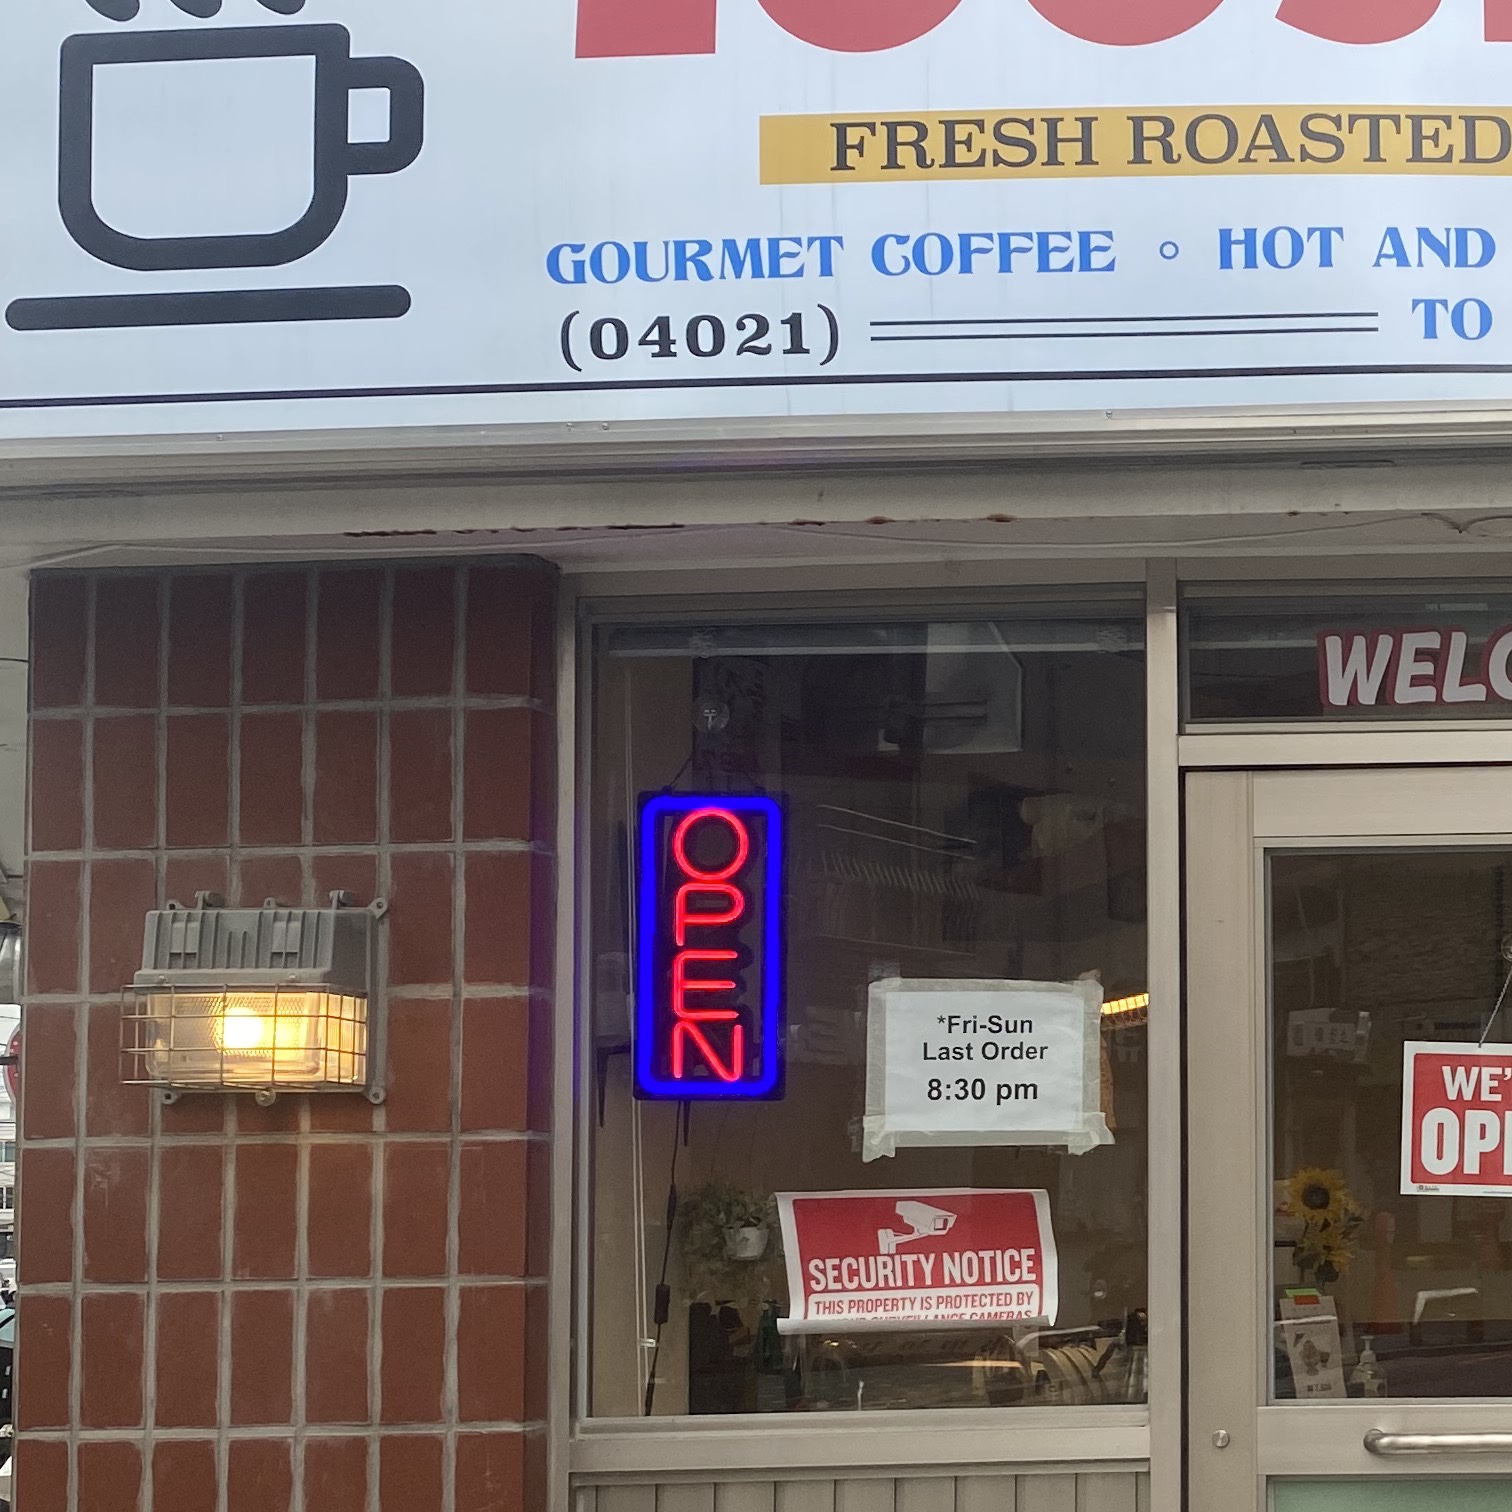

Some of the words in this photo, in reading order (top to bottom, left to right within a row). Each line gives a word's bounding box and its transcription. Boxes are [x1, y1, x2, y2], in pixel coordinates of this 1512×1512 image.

[830, 115, 1099, 171] FRESH
[1127, 113, 1512, 165] ROASTED
[545, 234, 845, 285] GOURMET
[870, 230, 1117, 277] COFFEE
[1218, 226, 1345, 271] HOT
[1374, 226, 1497, 269] AND
[560, 304, 840, 372] (04021)
[1411, 298, 1494, 341] TO
[673, 806, 750, 1083] OPEN
[923, 1041, 974, 1061] Last
[981, 1041, 1049, 1061] Order
[927, 1077, 986, 1101] 8:30
[996, 1081, 1039, 1106] pm
[808, 1253, 937, 1292] SECURITY
[943, 1248, 1037, 1285] NOTICE
[814, 1299, 844, 1315] THIS
[848, 1296, 917, 1314] PROPERTY
[920, 1295, 932, 1311] IS
[936, 1292, 1013, 1310] PROTECTED
[1016, 1290, 1034, 1306] BY
